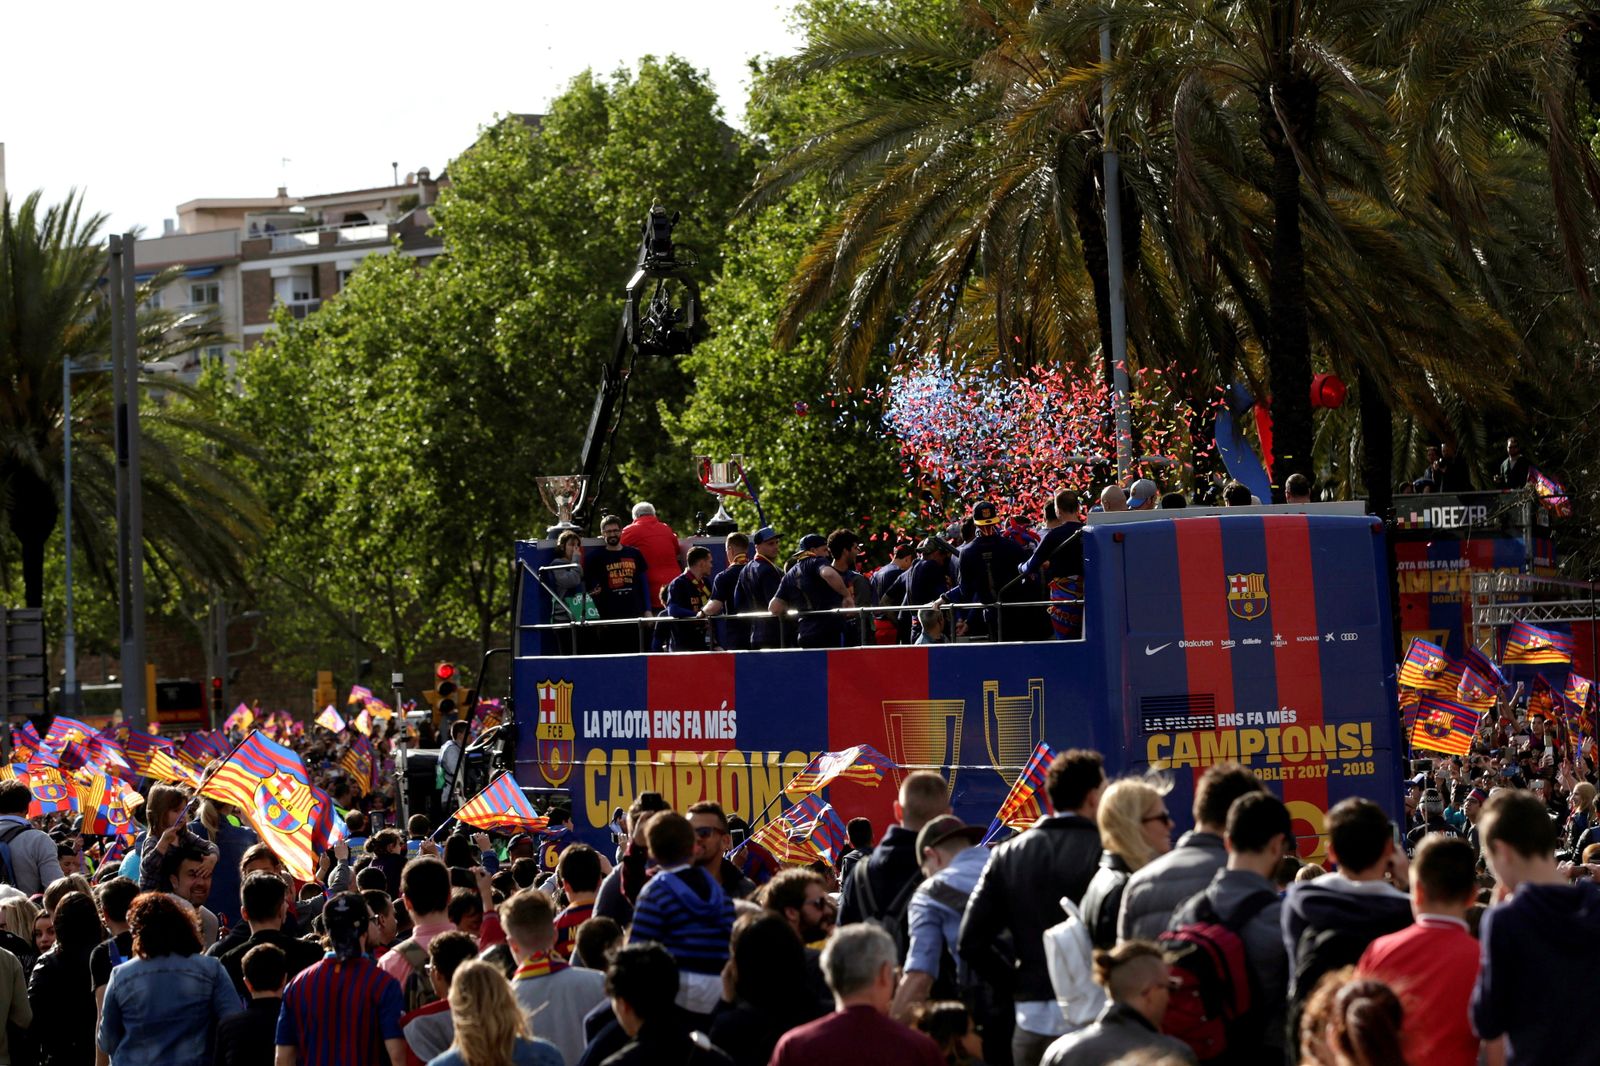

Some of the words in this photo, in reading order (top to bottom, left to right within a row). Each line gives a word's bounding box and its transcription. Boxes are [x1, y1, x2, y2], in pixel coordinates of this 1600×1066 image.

[1431, 506, 1487, 529] DEEZER
[1396, 561, 1416, 571] OTA
[1185, 640, 1214, 648] Rakuten
[1221, 639, 1236, 647] beko
[584, 711, 600, 738] LA
[603, 710, 650, 739] PILOTA
[653, 710, 680, 739] ENS
[684, 710, 702, 739] FA
[704, 700, 737, 739] MÉS
[1217, 712, 1244, 727] ENS
[1246, 711, 1265, 725] FA
[1266, 706, 1297, 724] MÉS
[547, 725, 563, 739] FCB
[1146, 722, 1374, 771] CAMPIONS!
[1251, 765, 1295, 781] OBLET
[1299, 764, 1329, 778] 2017
[1343, 761, 1375, 776] 2018
[544, 844, 560, 869] 6
